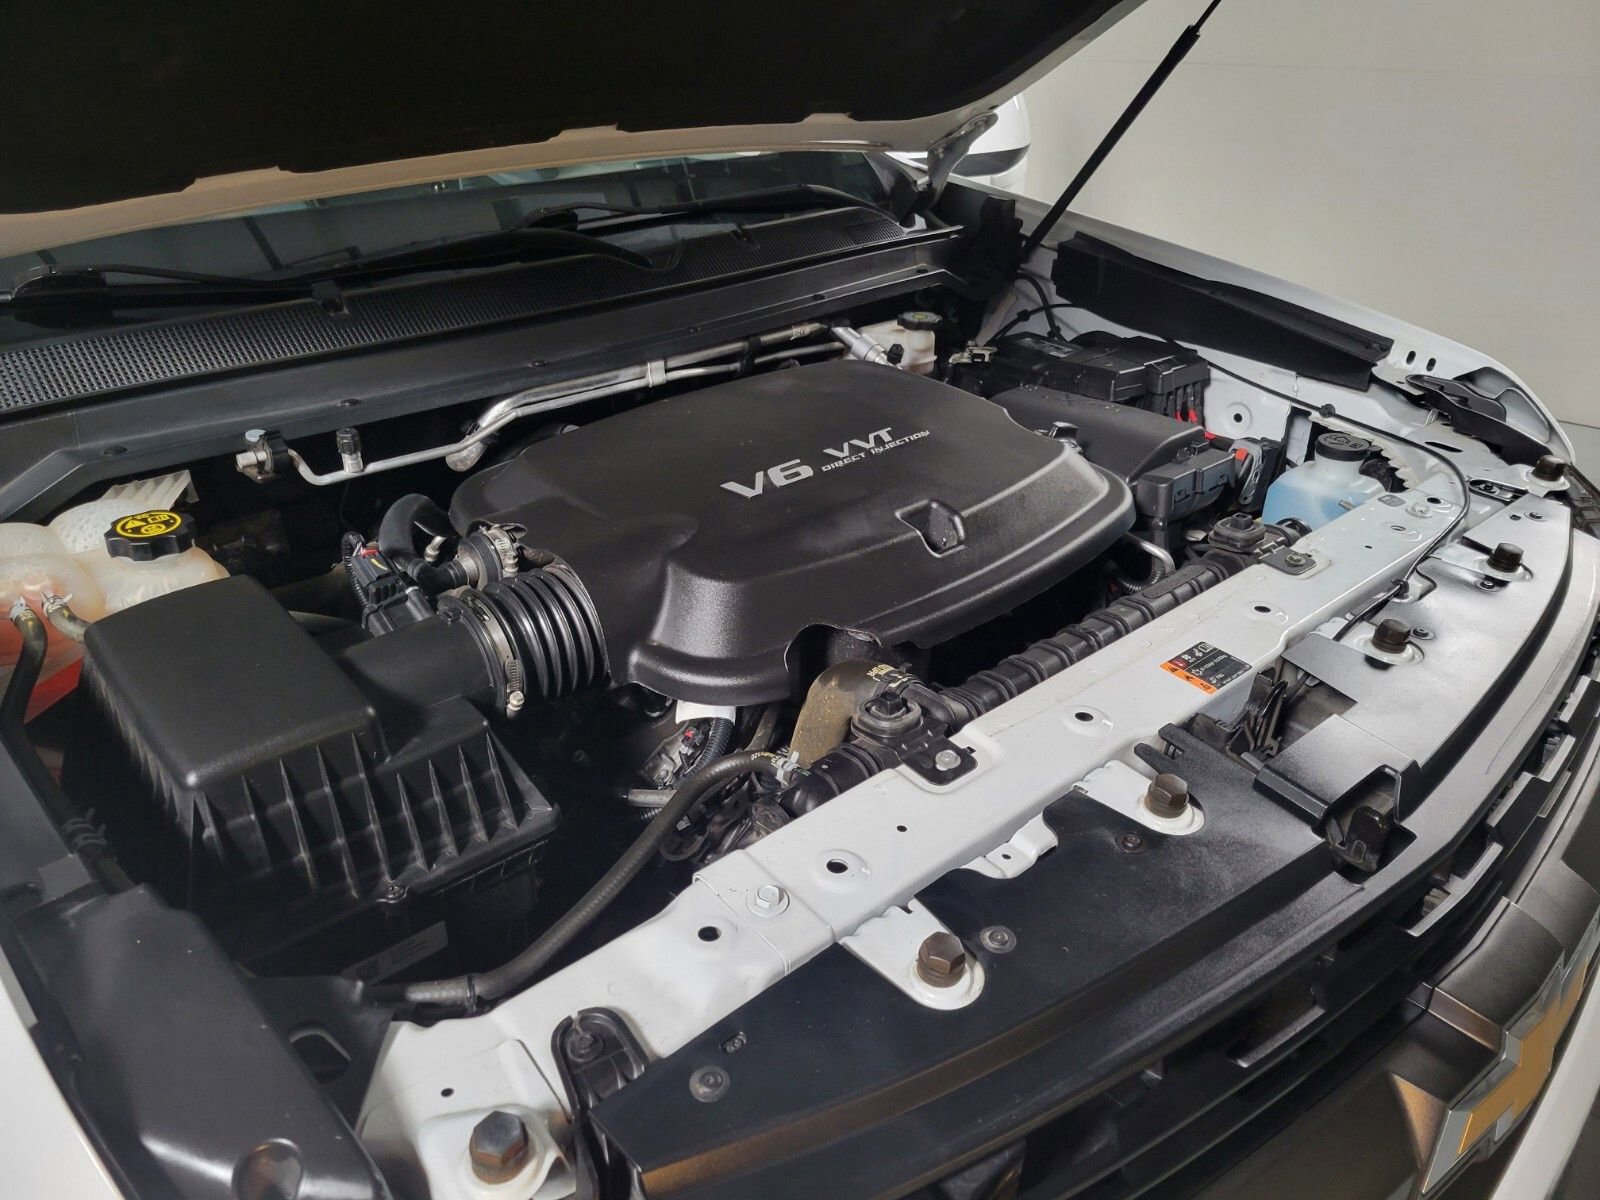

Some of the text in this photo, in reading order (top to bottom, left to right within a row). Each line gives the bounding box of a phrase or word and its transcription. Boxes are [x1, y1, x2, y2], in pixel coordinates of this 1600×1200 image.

[720, 427, 892, 498] V6 VVT
[821, 430, 930, 472] DIRECT INJECTION
